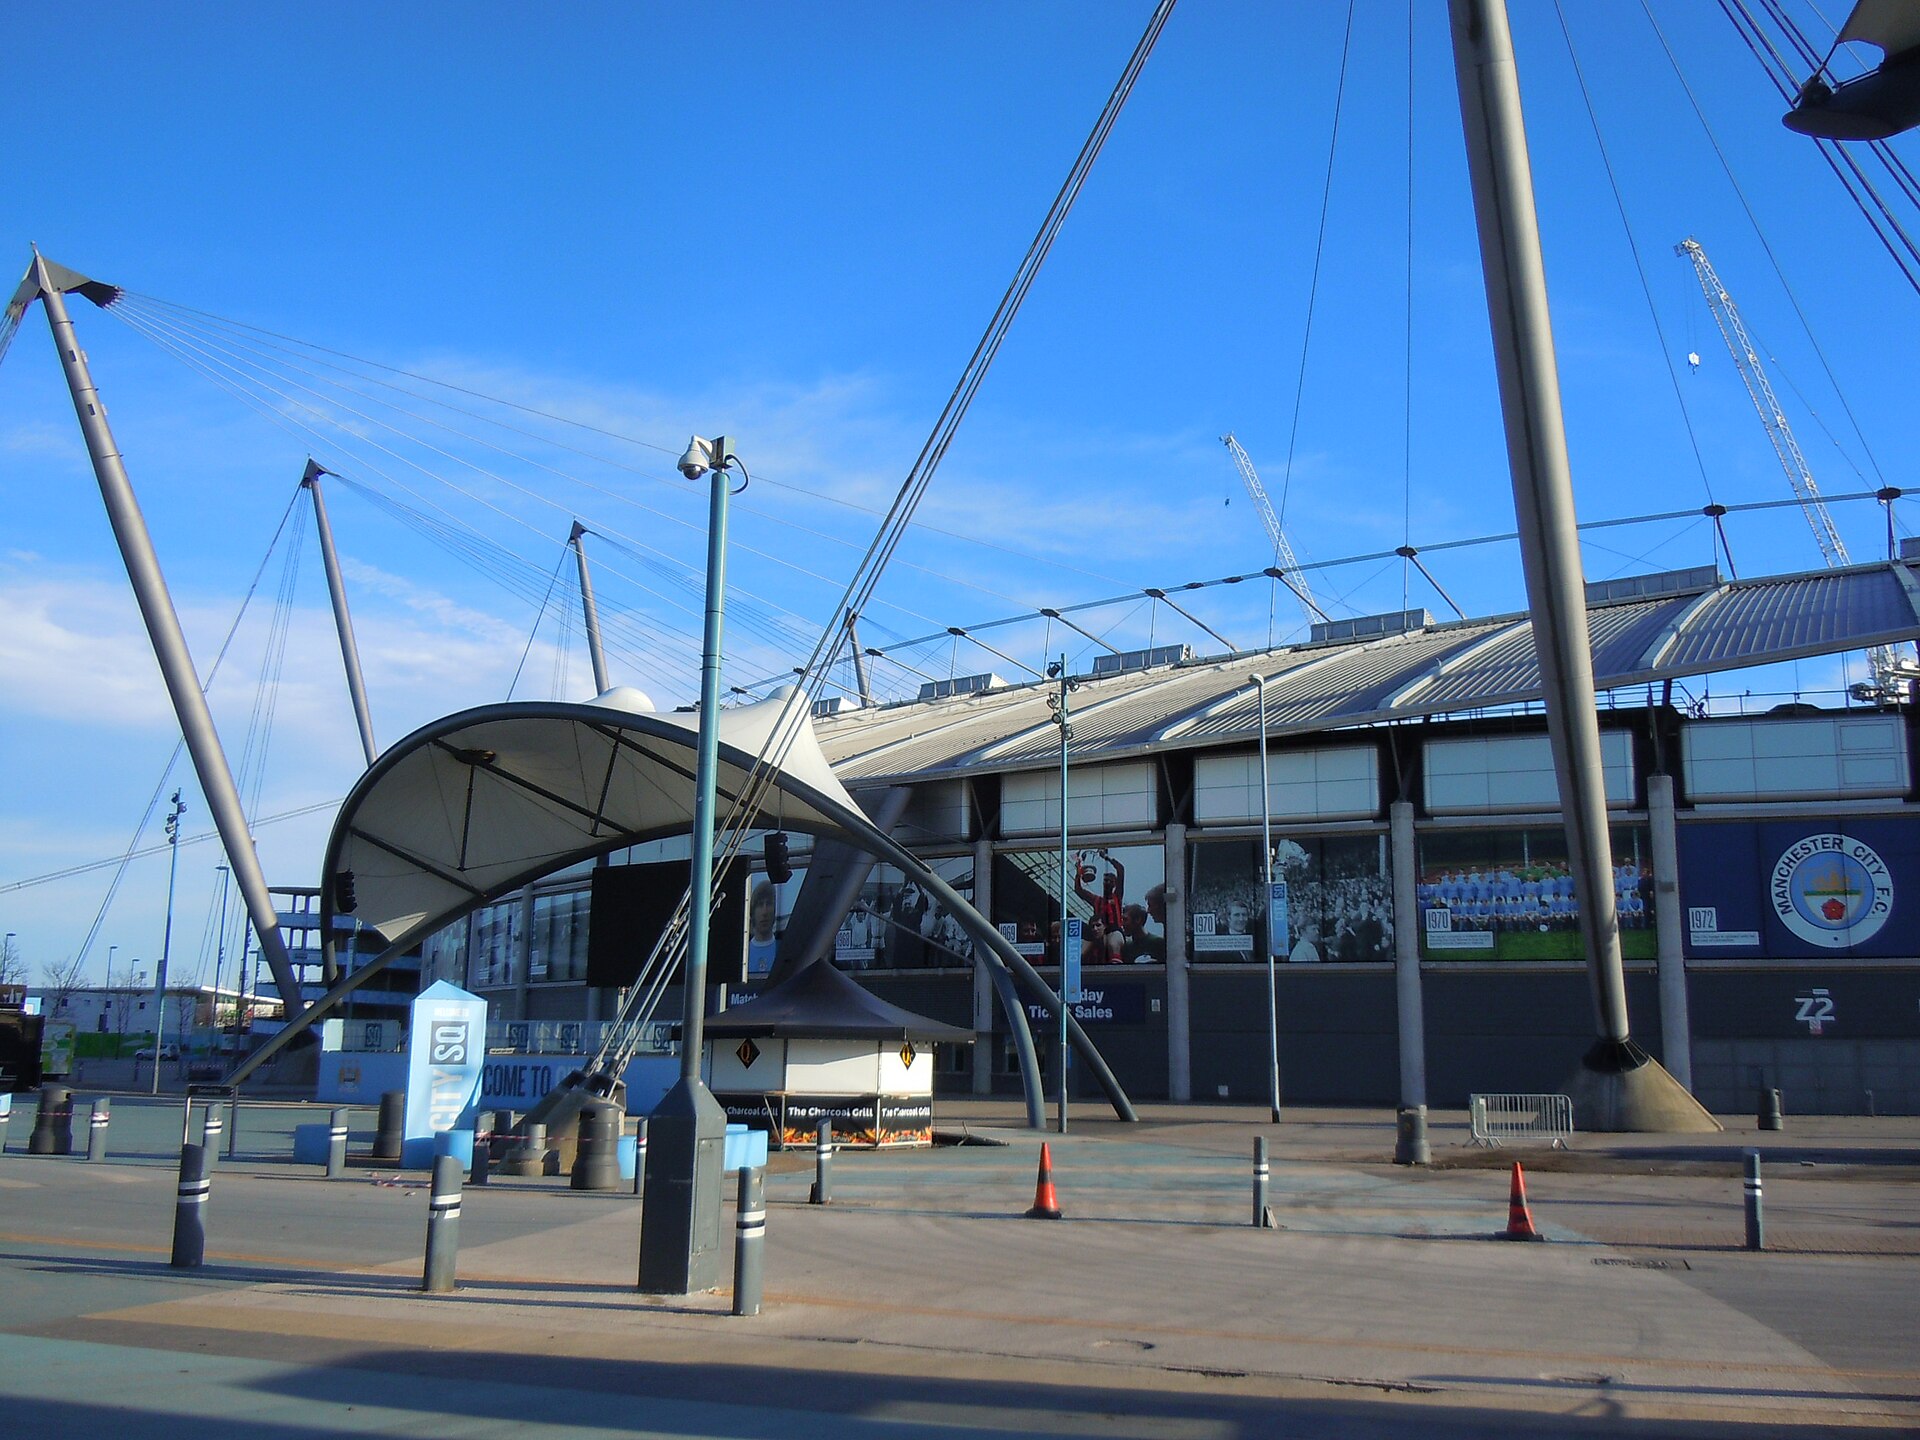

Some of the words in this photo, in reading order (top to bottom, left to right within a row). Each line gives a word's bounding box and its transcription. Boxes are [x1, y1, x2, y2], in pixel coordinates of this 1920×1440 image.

[1774, 837, 1843, 915] MANCHESTER
[1853, 846, 1885, 876] CITY
[1195, 916, 1213, 933] 1970
[1428, 912, 1448, 929] 1970
[1691, 910, 1713, 929] 1972
[1069, 921, 1079, 936] SQ
[1075, 1005, 1113, 1018] Sales
[434, 1025, 466, 1062] SQ
[532, 1065, 551, 1096] TO
[429, 1068, 462, 1131] CITY
[727, 1106, 760, 1115] Charcoal
[788, 1106, 806, 1116] The
[808, 1106, 851, 1117] Charcoal
[852, 1106, 873, 1117] Grill
